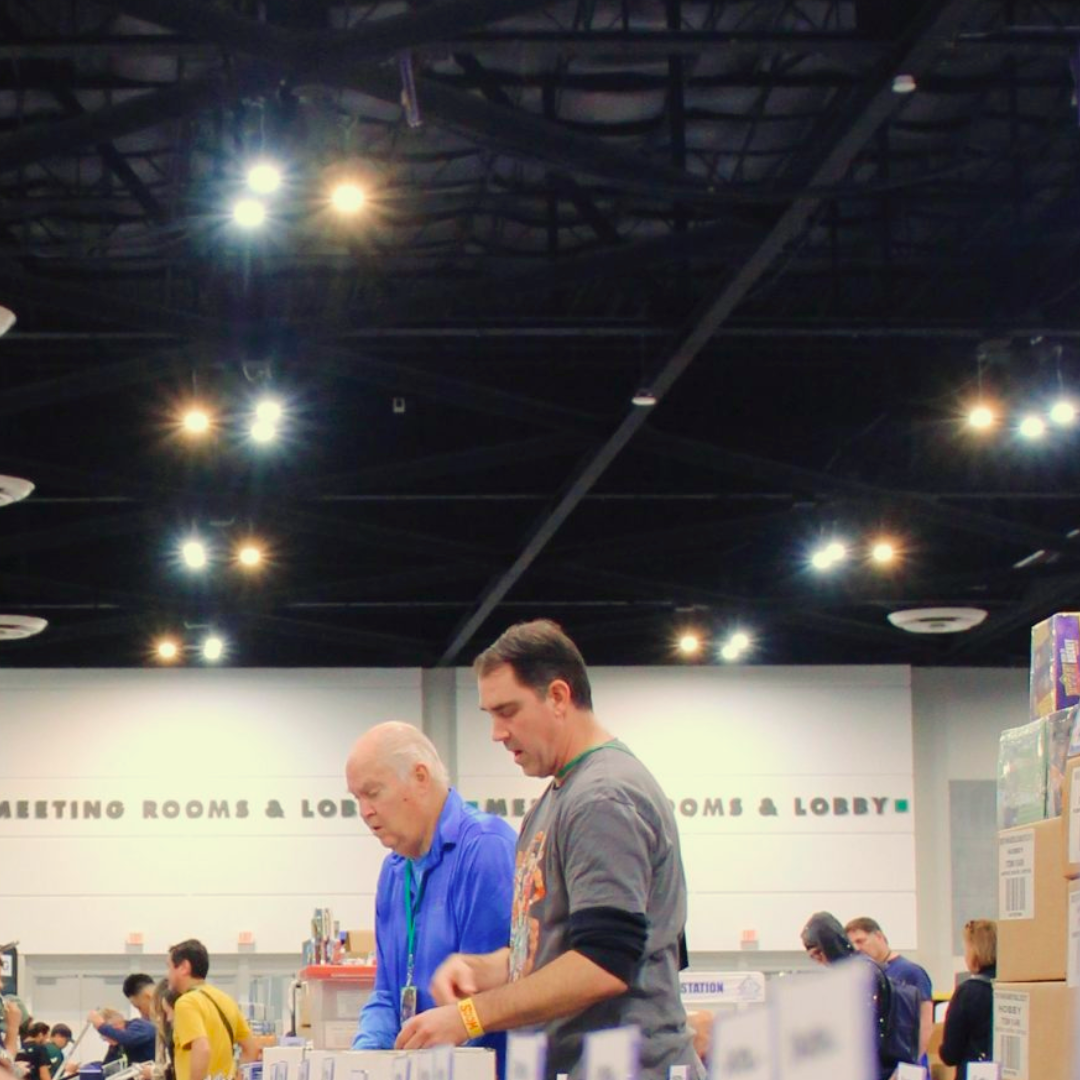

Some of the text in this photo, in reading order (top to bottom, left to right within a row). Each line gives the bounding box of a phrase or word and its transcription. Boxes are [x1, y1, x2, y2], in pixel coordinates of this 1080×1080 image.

[143, 799, 250, 819] ROOMS
[265, 799, 284, 819] &
[486, 797, 888, 817] ME OMS & LOBBY
[680, 981, 724, 994] STATION
